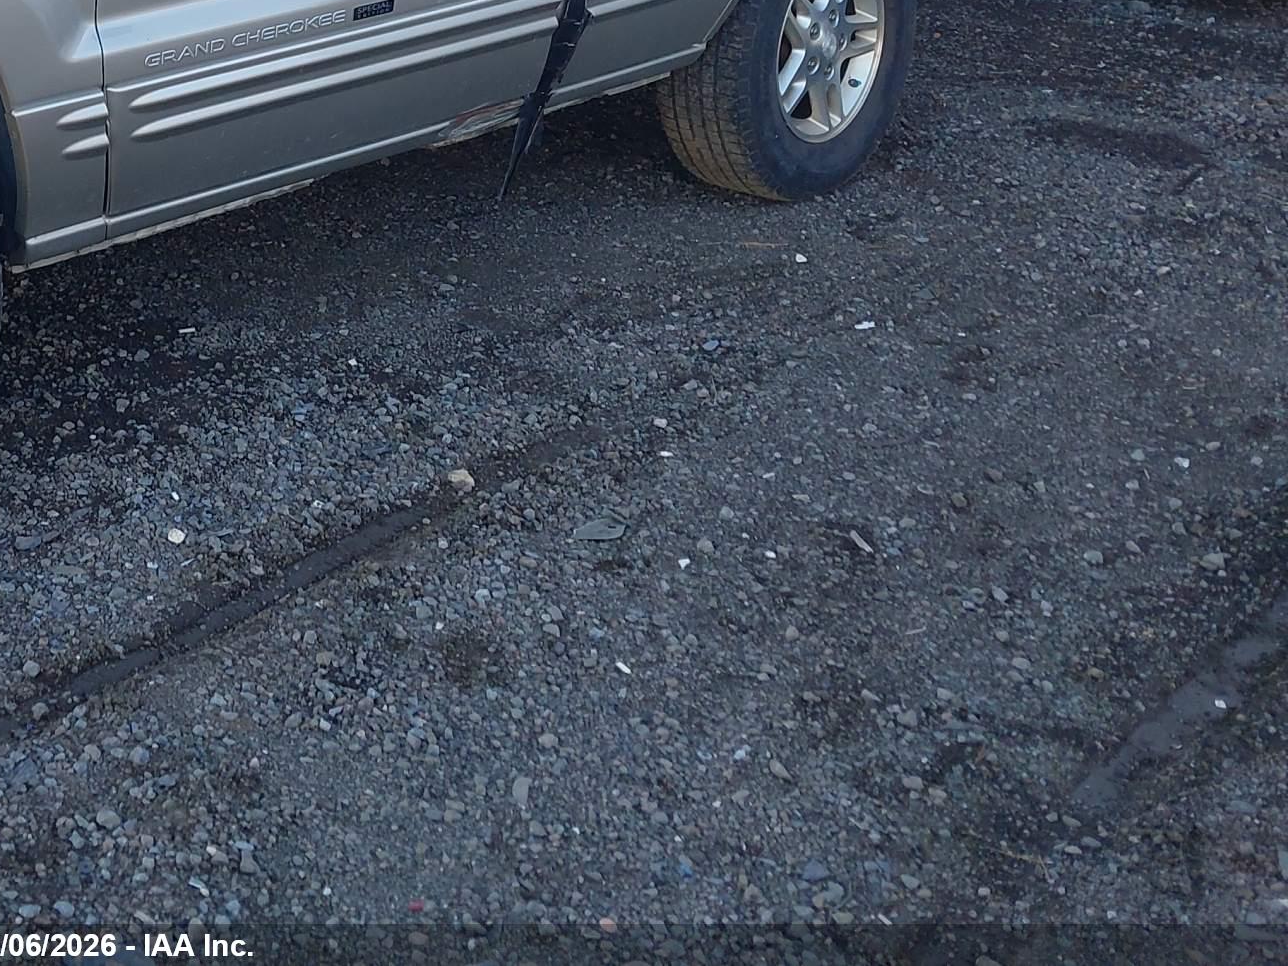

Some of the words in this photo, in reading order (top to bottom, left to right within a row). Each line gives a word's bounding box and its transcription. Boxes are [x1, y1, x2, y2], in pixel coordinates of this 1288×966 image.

[357, 1, 393, 15] SPECIAL
[143, 37, 227, 68] GRAND
[231, 9, 347, 47] CHEROKEE
